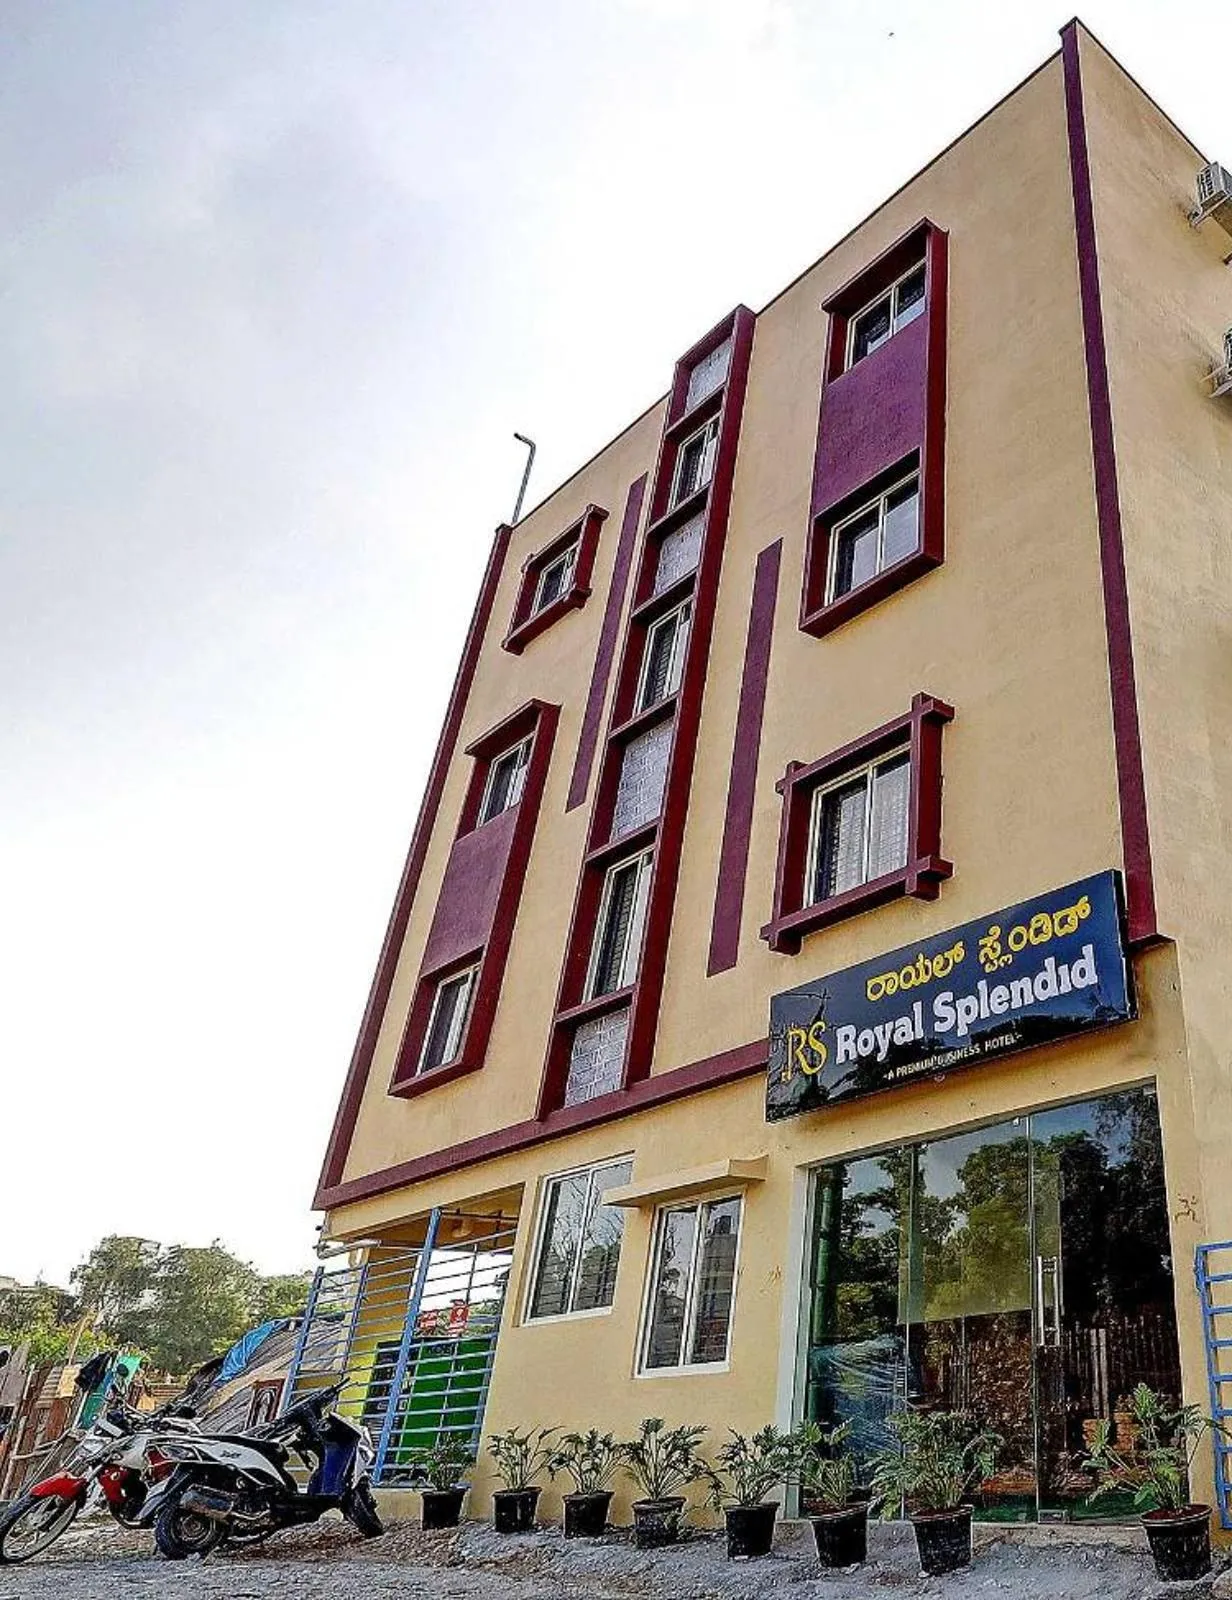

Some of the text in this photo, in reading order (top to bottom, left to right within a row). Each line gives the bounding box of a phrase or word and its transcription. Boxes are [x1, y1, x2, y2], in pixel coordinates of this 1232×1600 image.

[865, 940, 965, 1002] ರಾಯಲ್
[835, 944, 1098, 1065] Royal Splendid
[781, 1021, 829, 1082] RS
